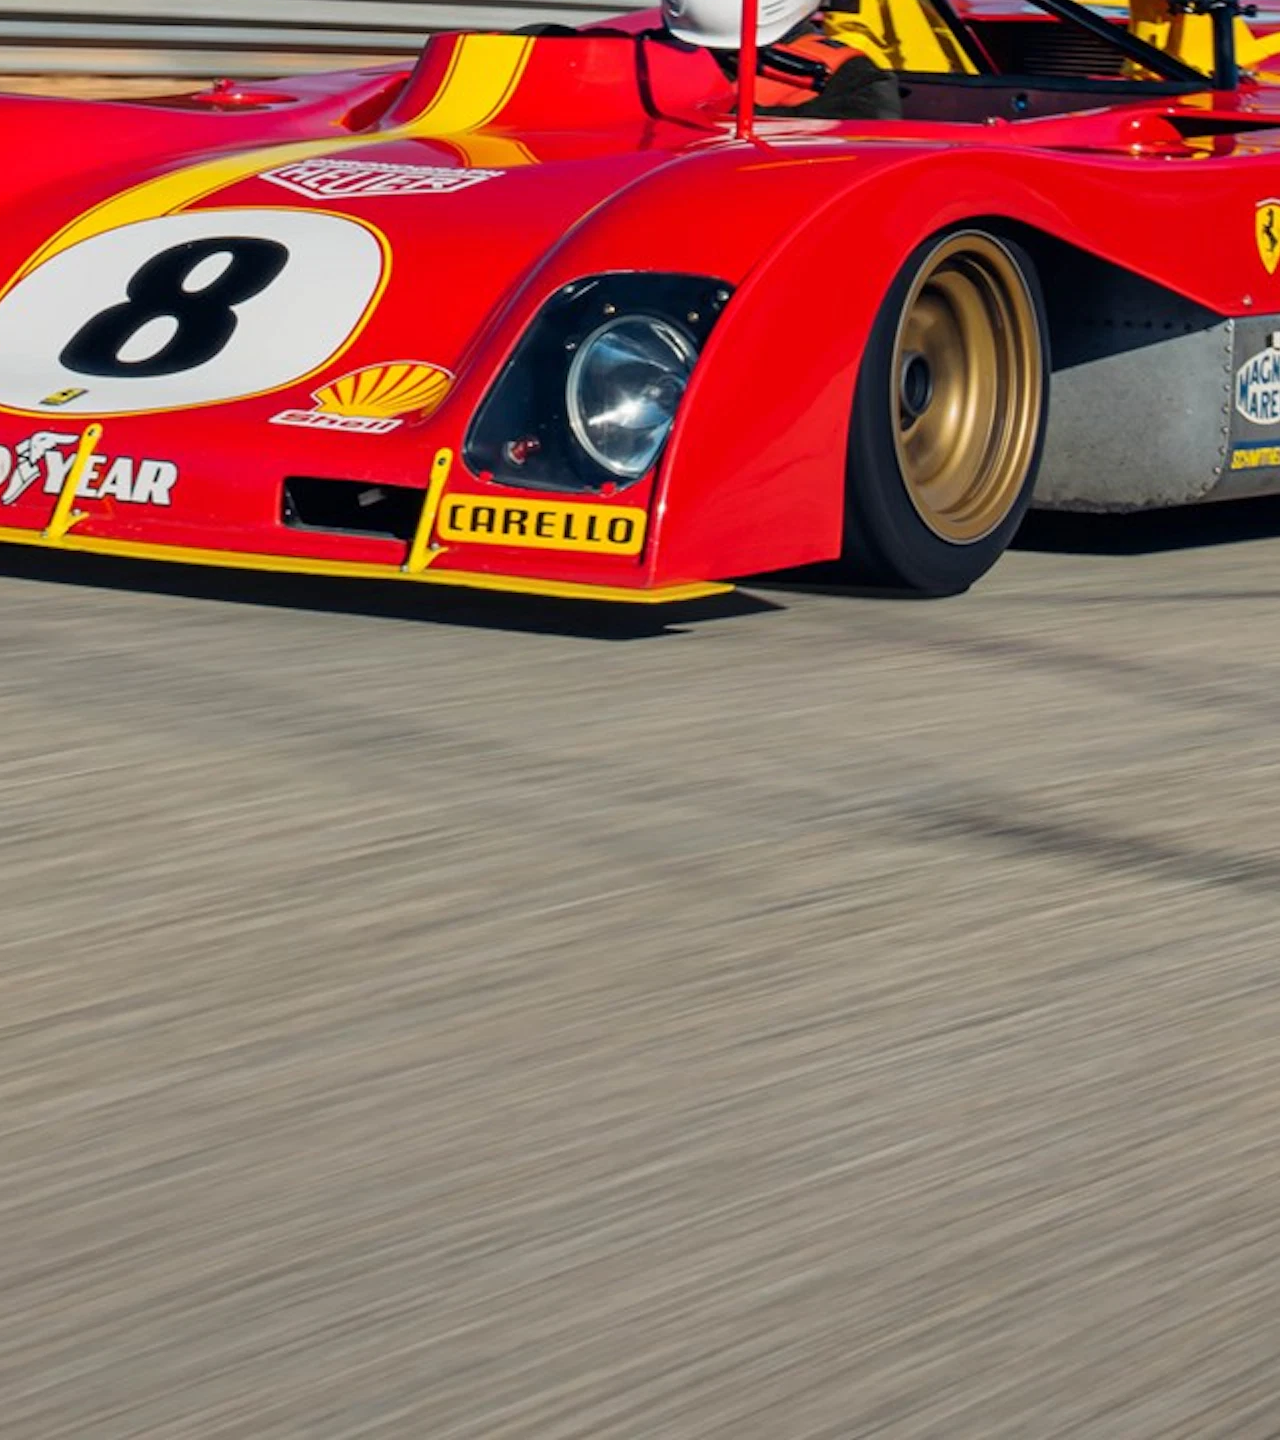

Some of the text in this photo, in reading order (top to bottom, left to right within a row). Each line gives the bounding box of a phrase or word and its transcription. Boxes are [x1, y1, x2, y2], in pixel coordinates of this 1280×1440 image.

[58, 236, 290, 378] 8
[280, 412, 395, 431] Shell
[447, 503, 636, 546] CARELLO
